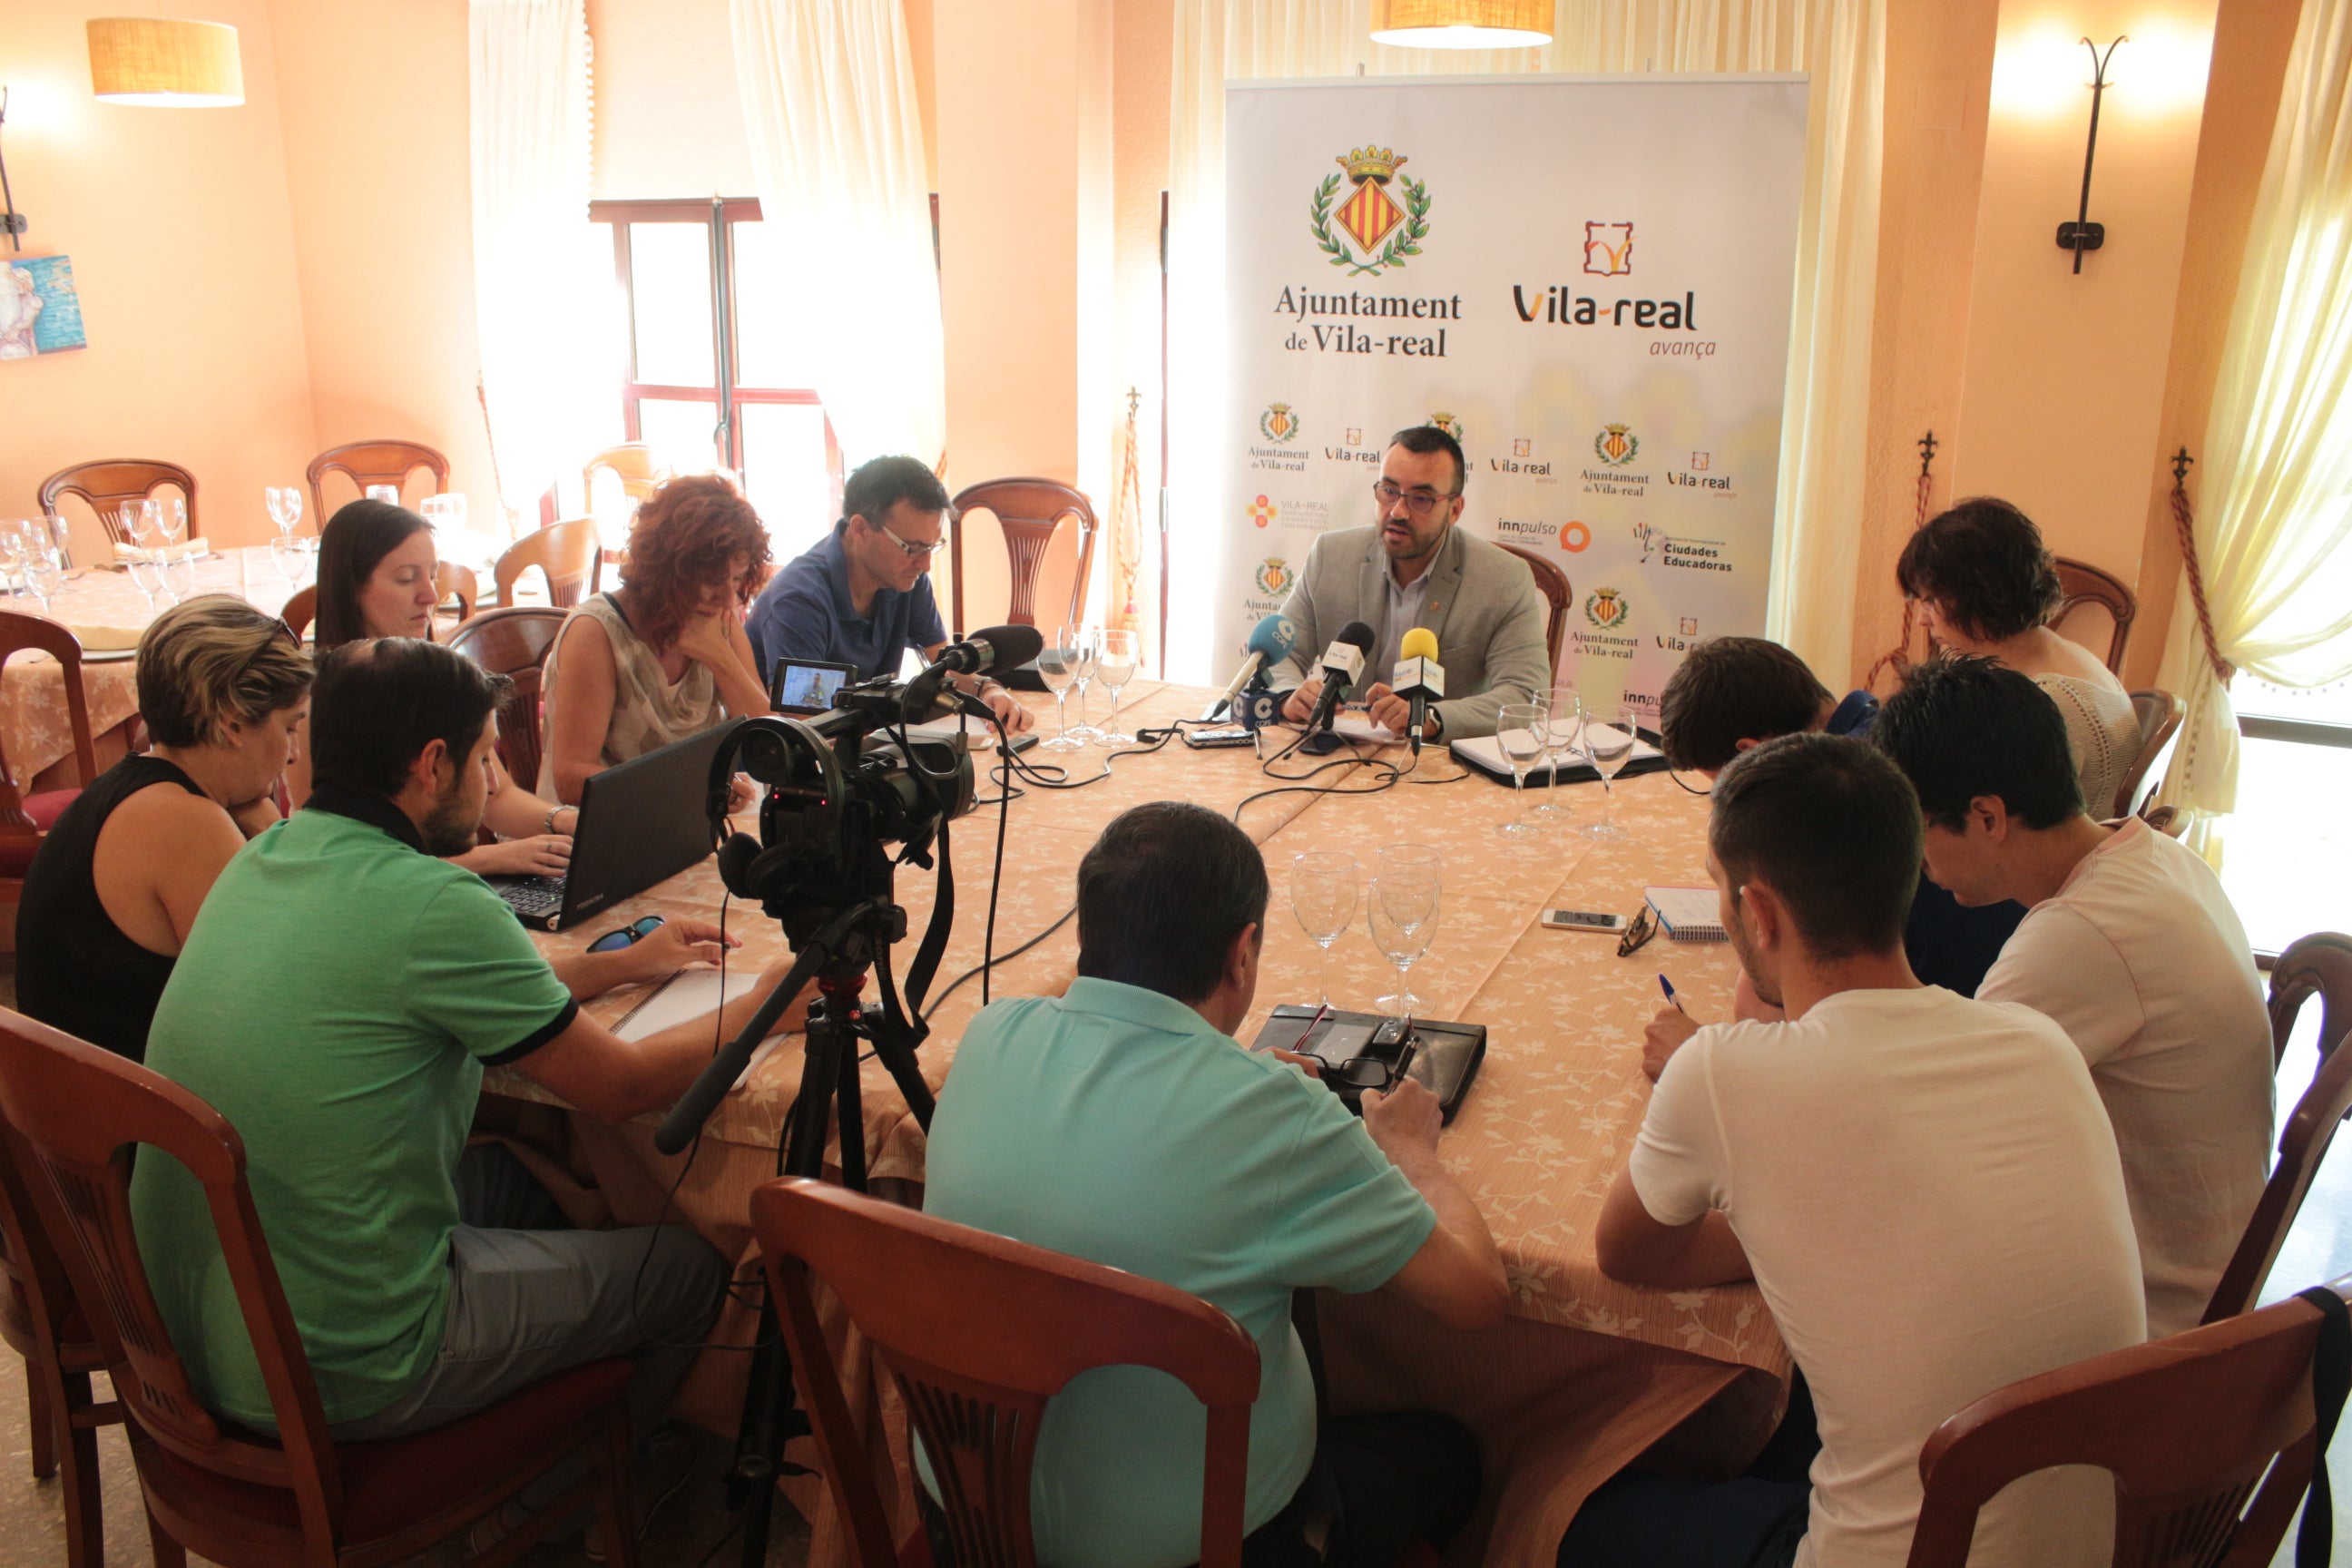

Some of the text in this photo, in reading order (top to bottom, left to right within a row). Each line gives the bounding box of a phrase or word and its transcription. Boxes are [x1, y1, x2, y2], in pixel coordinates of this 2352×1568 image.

[1273, 285, 1462, 323] Ajuntament
[1513, 285, 1698, 331] Vila-real
[1285, 324, 1447, 358] de Vila-real
[1650, 341, 1717, 360] avança
[1248, 446, 1309, 460] Ajuntament
[1325, 446, 1381, 464] Vila-real
[1260, 458, 1305, 471] Vila-real
[1491, 458, 1551, 475] Vila-real
[1580, 469, 1650, 485] Ajuntament
[1668, 471, 1731, 490] Vila-real
[1583, 483, 1644, 497] de Vila-real
[1497, 517, 1558, 535] innpulso
[1664, 543, 1720, 558] Ciudades
[1663, 555, 1733, 573] Educadoras
[1244, 598, 1282, 611] Ajunta
[1571, 631, 1639, 647] Ajuntament
[1656, 635, 1696, 652] Vila-r
[1583, 645, 1633, 660] Vila-real
[1623, 690, 1662, 707] innpu
